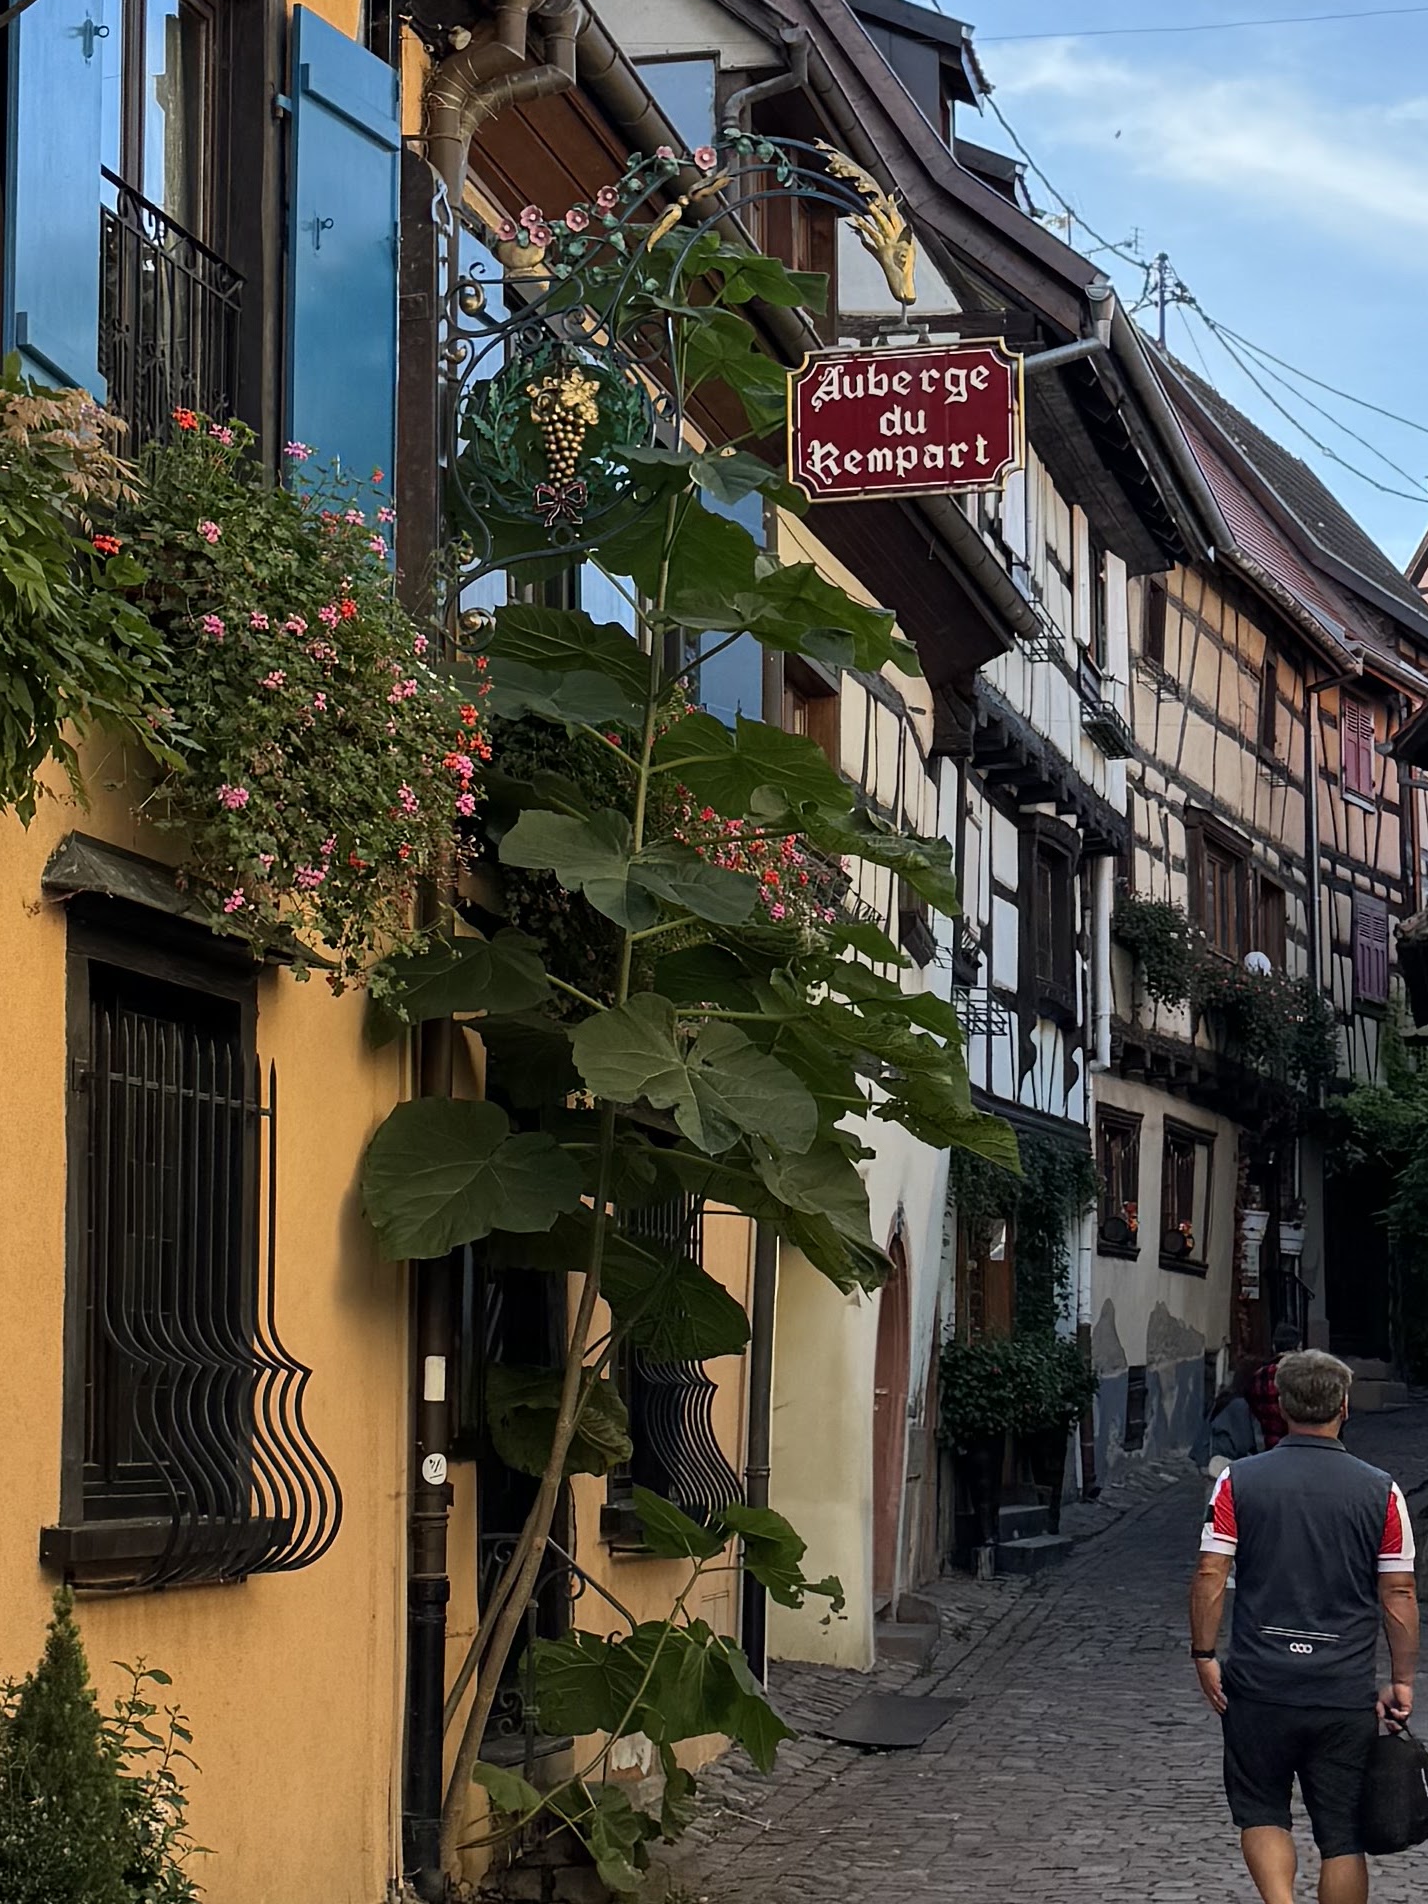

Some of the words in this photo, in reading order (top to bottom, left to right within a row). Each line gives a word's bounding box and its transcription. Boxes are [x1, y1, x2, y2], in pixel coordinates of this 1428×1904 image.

[811, 363, 990, 412] Auberge
[879, 404, 927, 437] du
[806, 433, 990, 485] Rempart
